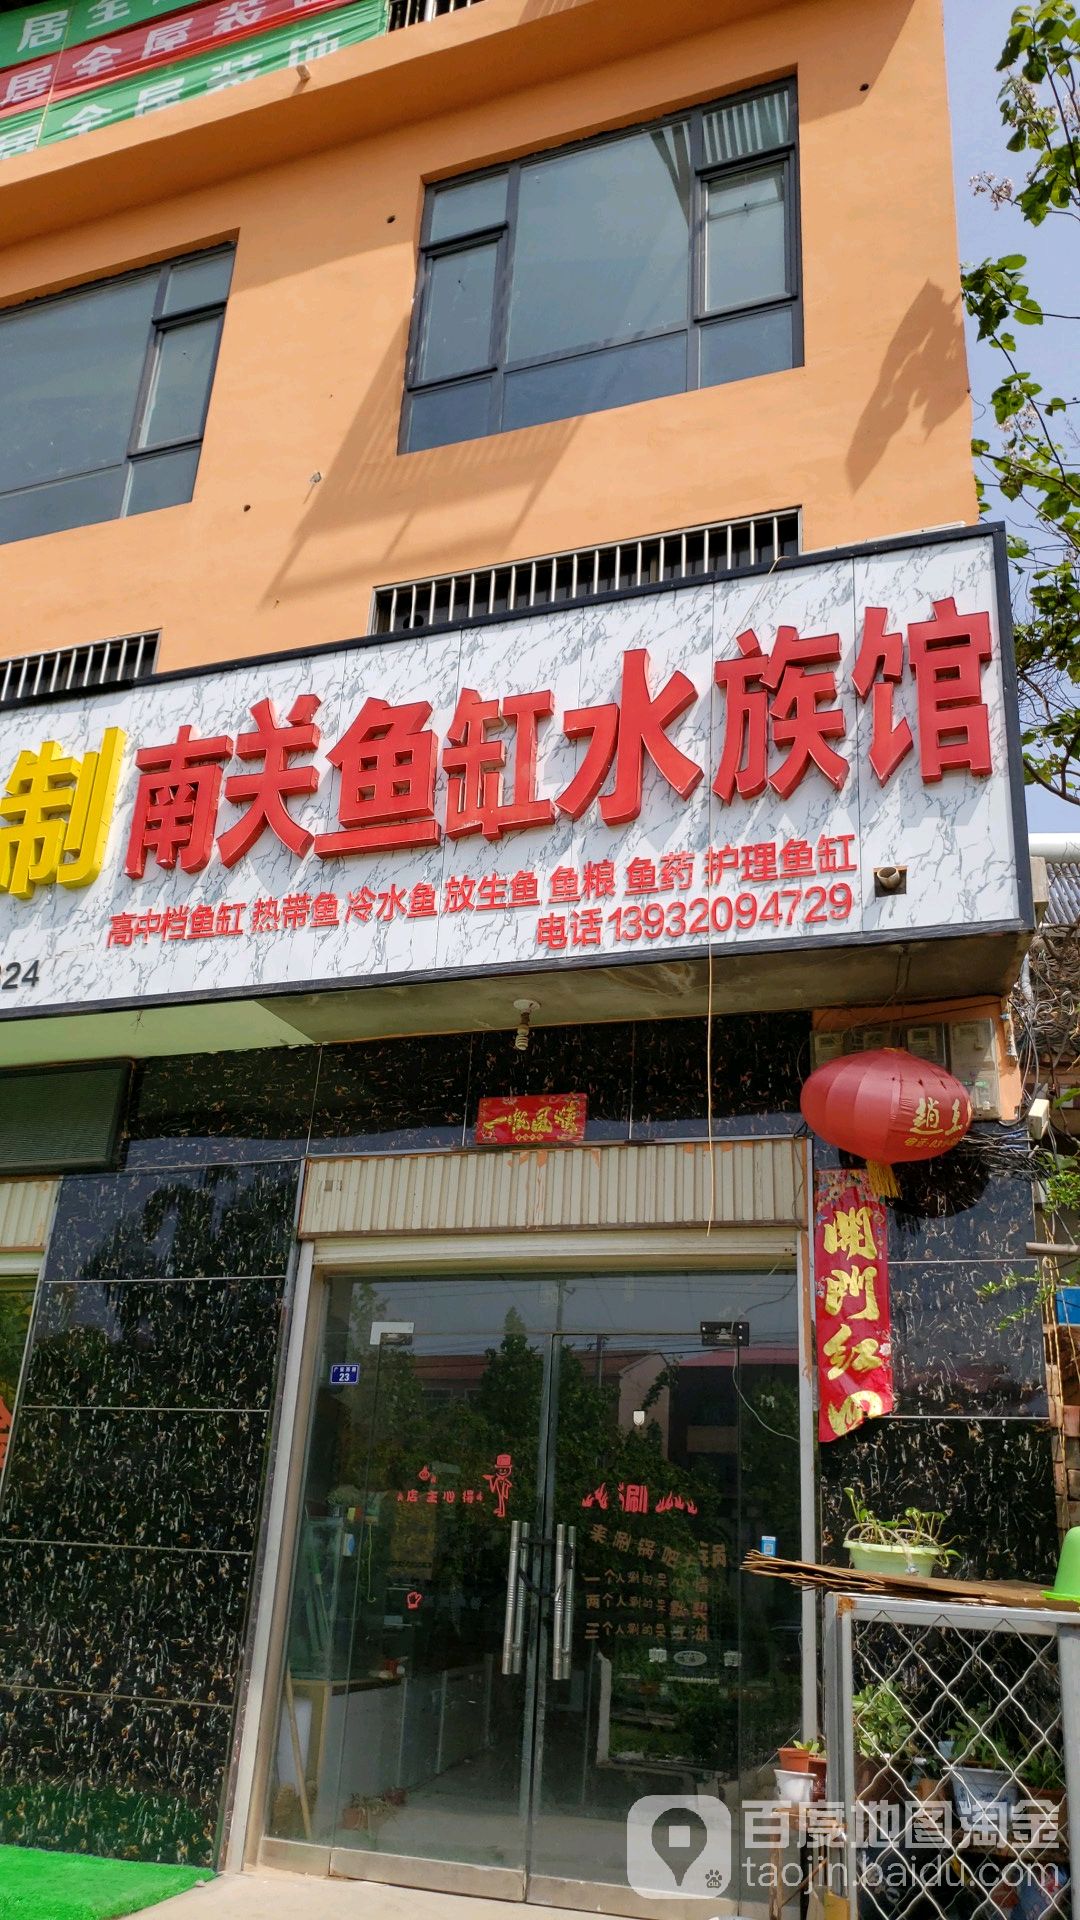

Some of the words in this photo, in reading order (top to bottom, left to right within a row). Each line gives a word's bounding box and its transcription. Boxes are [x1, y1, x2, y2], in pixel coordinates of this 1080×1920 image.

[125, 597, 993, 880] 南关鱼缸水族馆
[0, 726, 127, 899] 制
[106, 902, 246, 948] 高中档鱼缸
[250, 891, 340, 932] 热带鱼
[344, 882, 438, 924] 冷水鱼
[443, 870, 541, 914] 放生鱼
[548, 858, 616, 903] 鱼粮
[624, 850, 694, 895] 鱼药
[705, 833, 857, 887] 护理鱼缸
[338, 1372, 350, 1381] 23
